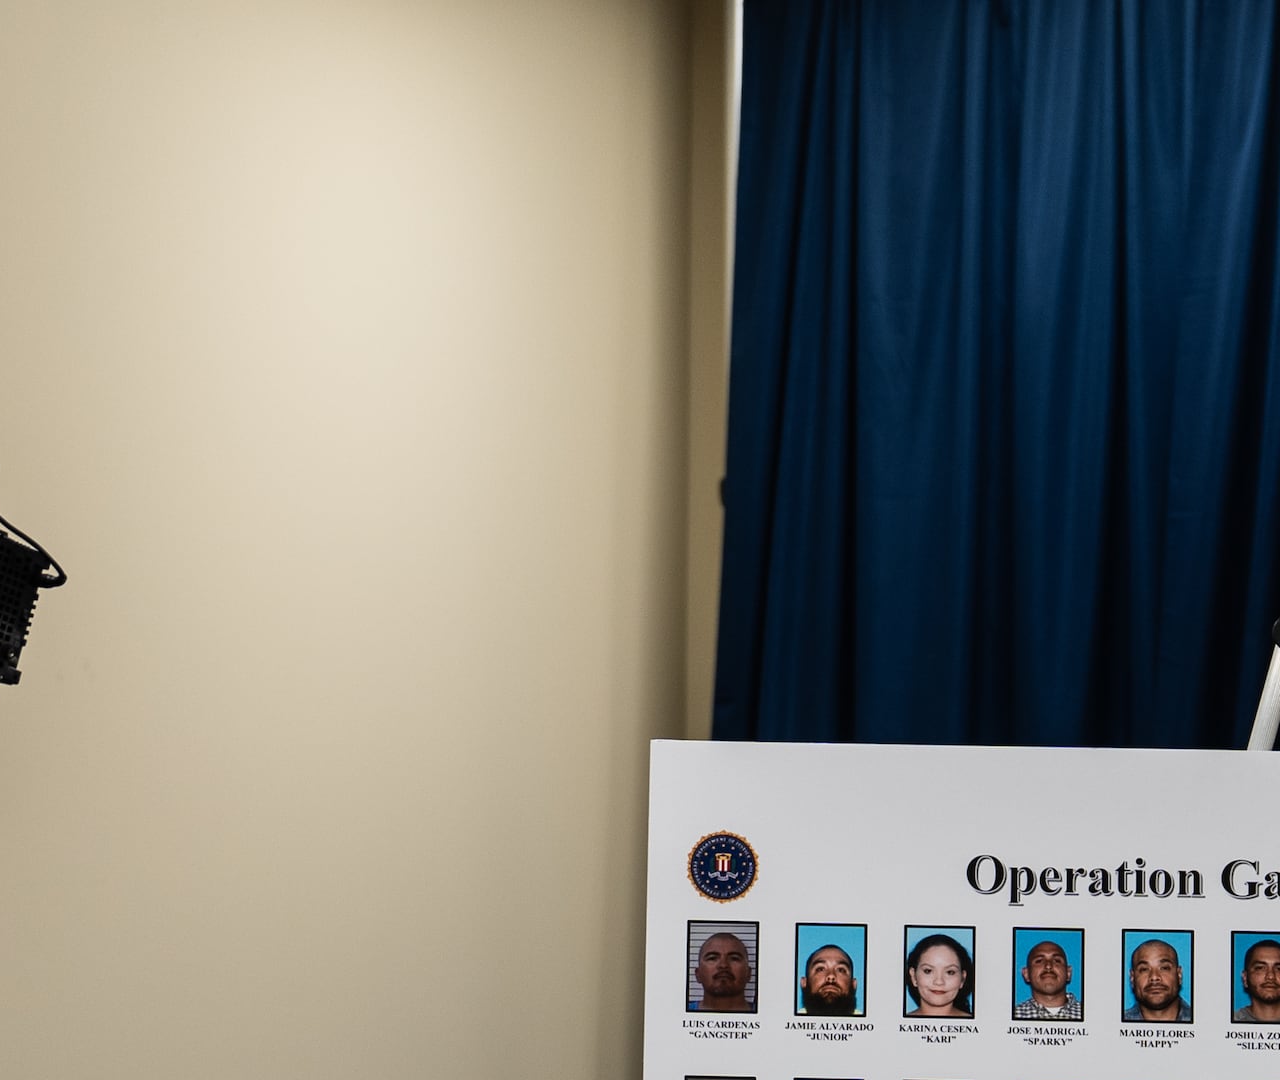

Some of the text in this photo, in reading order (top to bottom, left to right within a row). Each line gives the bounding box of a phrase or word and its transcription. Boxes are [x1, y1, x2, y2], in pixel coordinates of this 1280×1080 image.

[966, 854, 1206, 907] Operation
[682, 1019, 761, 1029] LUIS CARDENAS
[784, 1021, 874, 1031] JAMIE ALVARADO
[898, 1023, 979, 1034] KARINA CESENA
[1006, 1026, 1089, 1036] JOSE MADRIGAL
[1119, 1028, 1195, 1038] MARIO FLORES
[1224, 1030, 1265, 1040] JOSHUA
